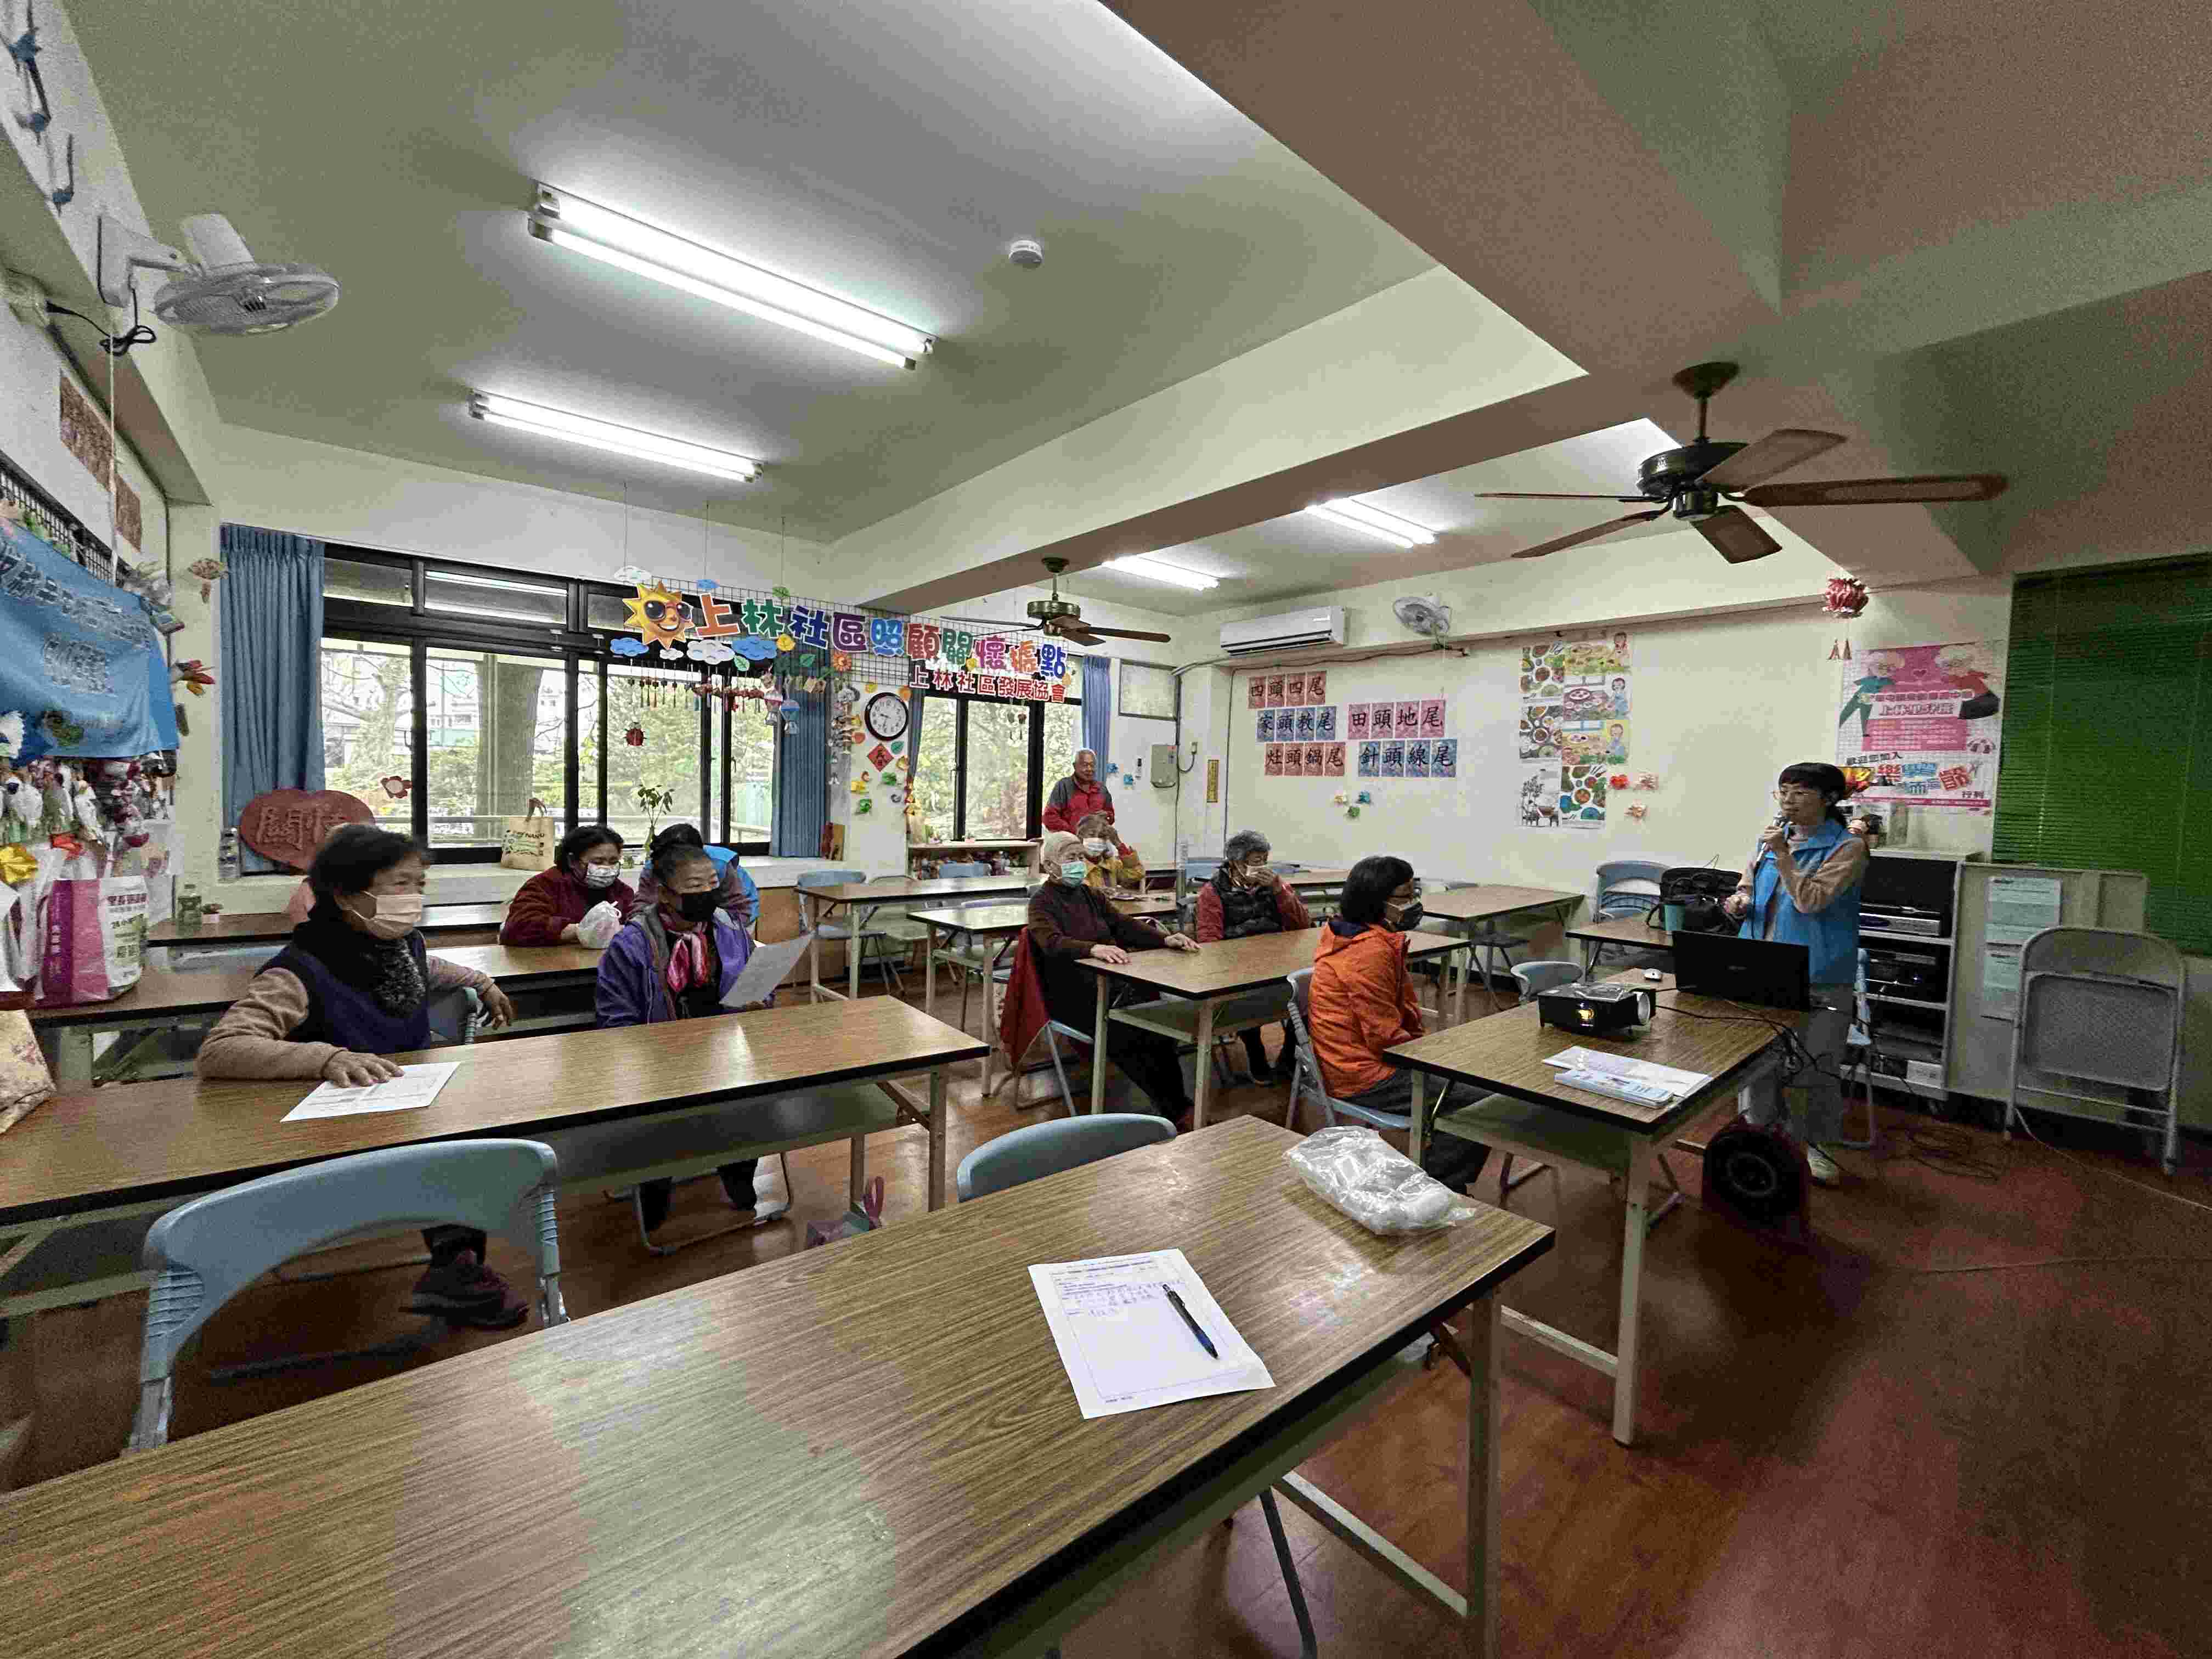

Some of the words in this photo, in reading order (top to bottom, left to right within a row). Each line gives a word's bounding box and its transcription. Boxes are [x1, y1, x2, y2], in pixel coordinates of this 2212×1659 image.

[695, 593, 1066, 679] 上林社區照顧關懷據點
[910, 665, 1066, 702] 上林社區發展協會
[1250, 676, 1324, 698] 四頭四尾
[1260, 712, 1333, 733] 家頭教尾
[1352, 706, 1443, 729] 田頭地尾
[1266, 747, 1344, 767] 灶頭鍋尾
[1360, 745, 1453, 767] 針頭線尾
